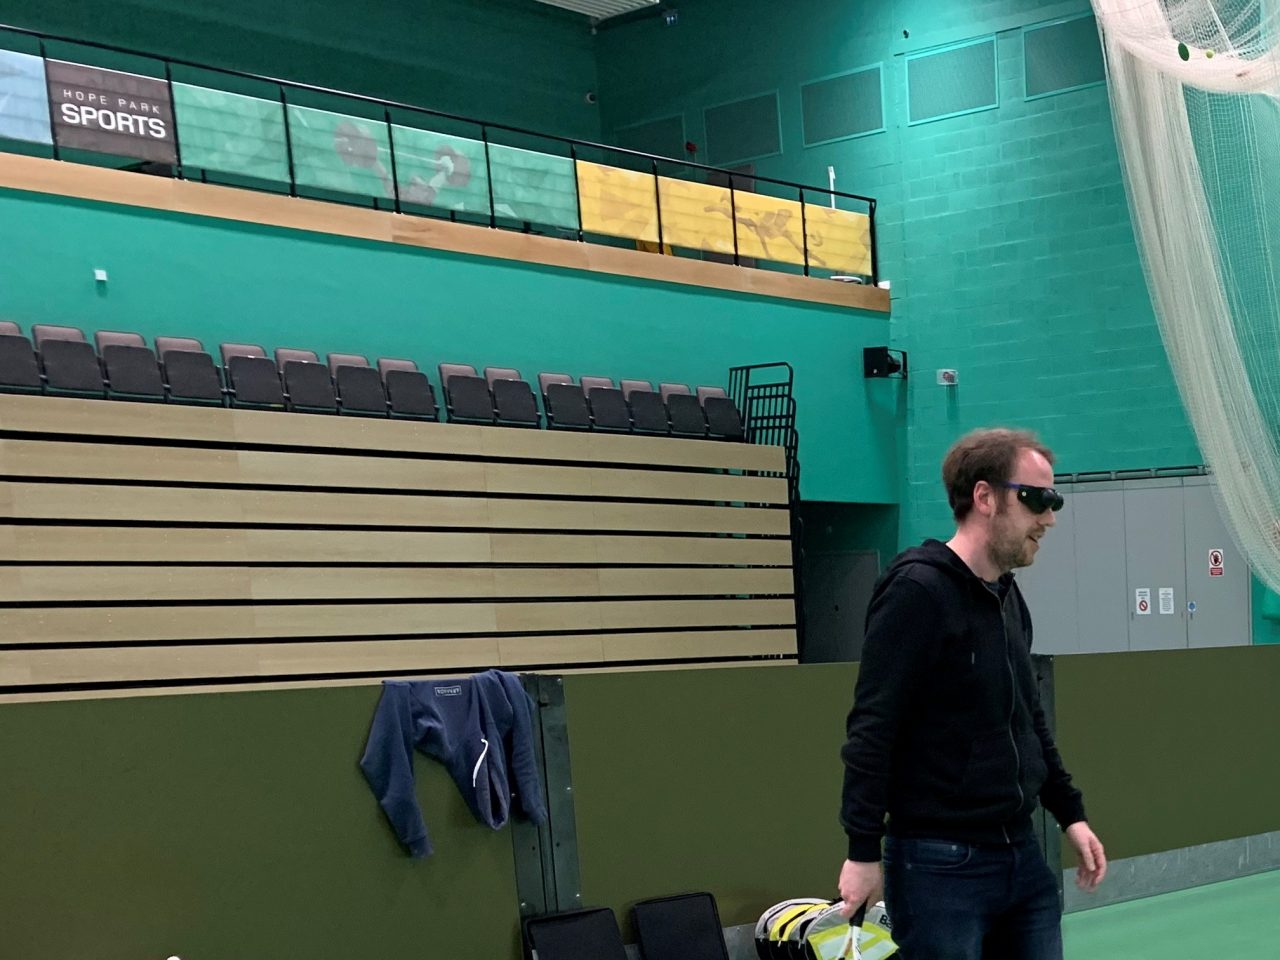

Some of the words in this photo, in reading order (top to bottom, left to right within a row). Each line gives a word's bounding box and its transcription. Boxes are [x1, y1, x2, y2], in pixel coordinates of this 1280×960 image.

[63, 89, 107, 105] HOPE
[118, 98, 160, 114] PARK
[61, 103, 166, 138] SPORTS
